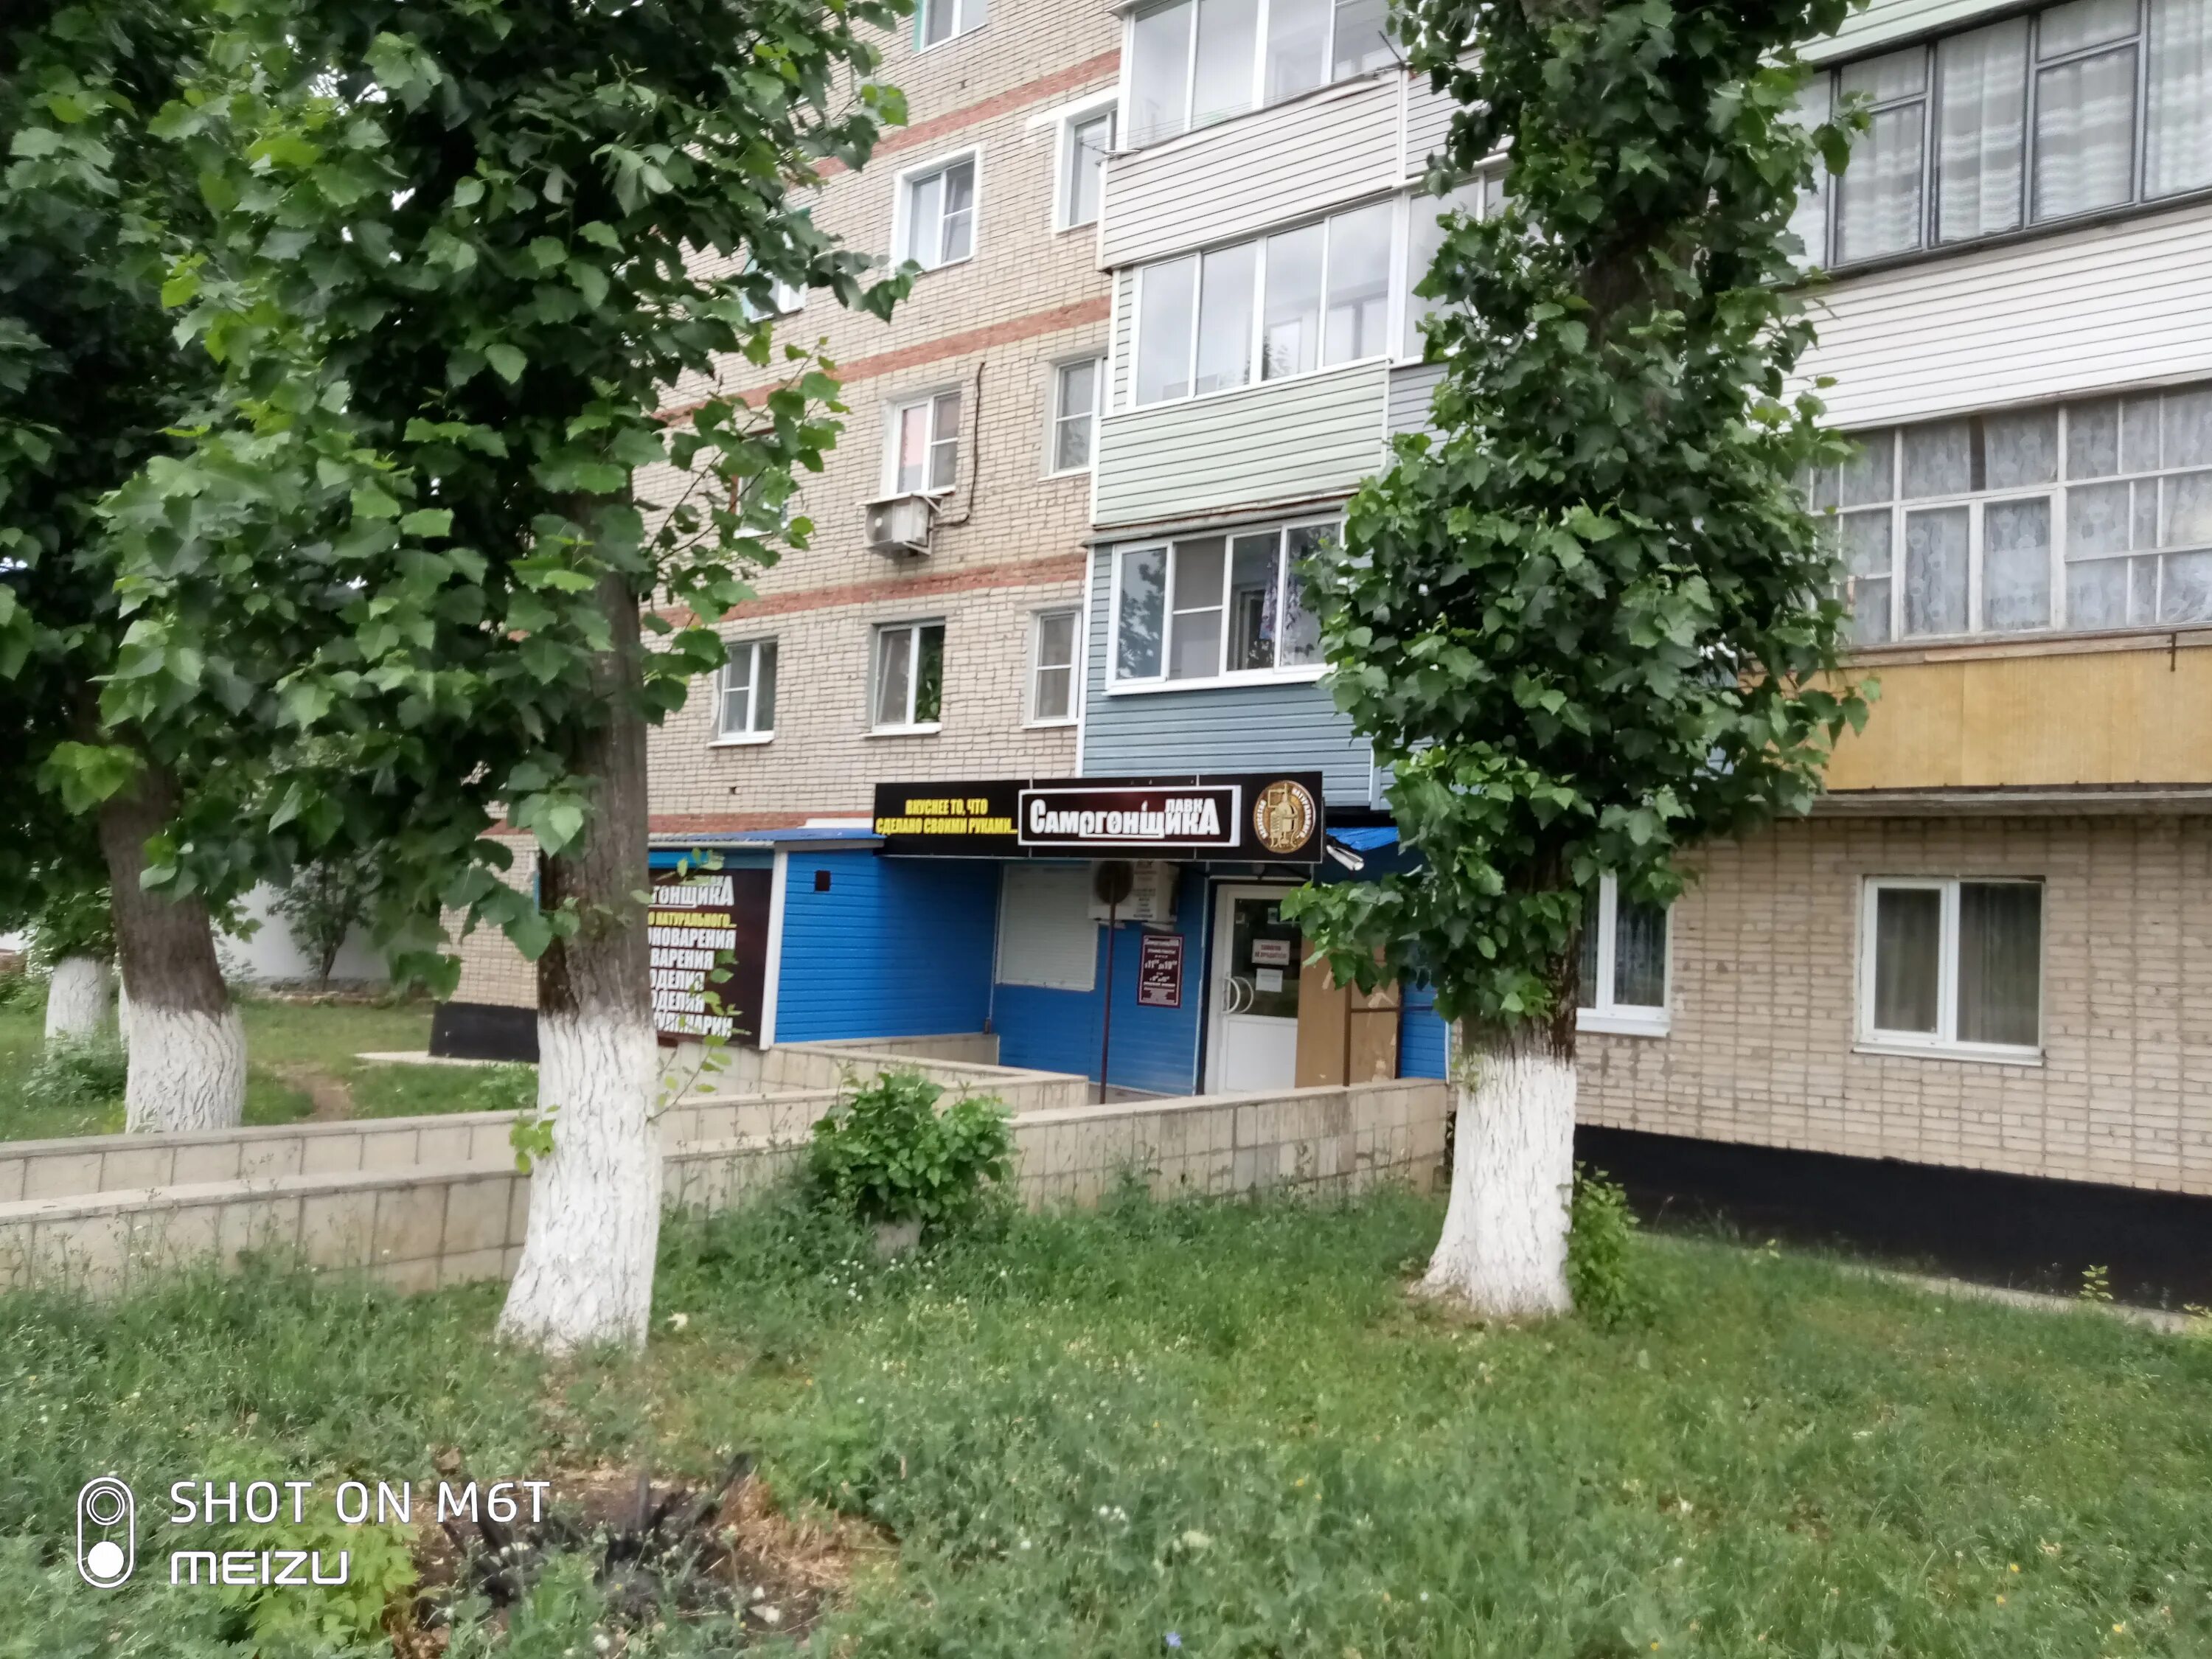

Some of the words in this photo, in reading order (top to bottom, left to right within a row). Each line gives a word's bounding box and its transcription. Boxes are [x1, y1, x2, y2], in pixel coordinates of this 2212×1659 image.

[905, 799, 950, 815] ВКУСНЕЕ
[967, 798, 988, 815] ЧТО
[875, 818, 922, 835] СДЕЛАНО
[923, 818, 967, 834] СВОИМИ
